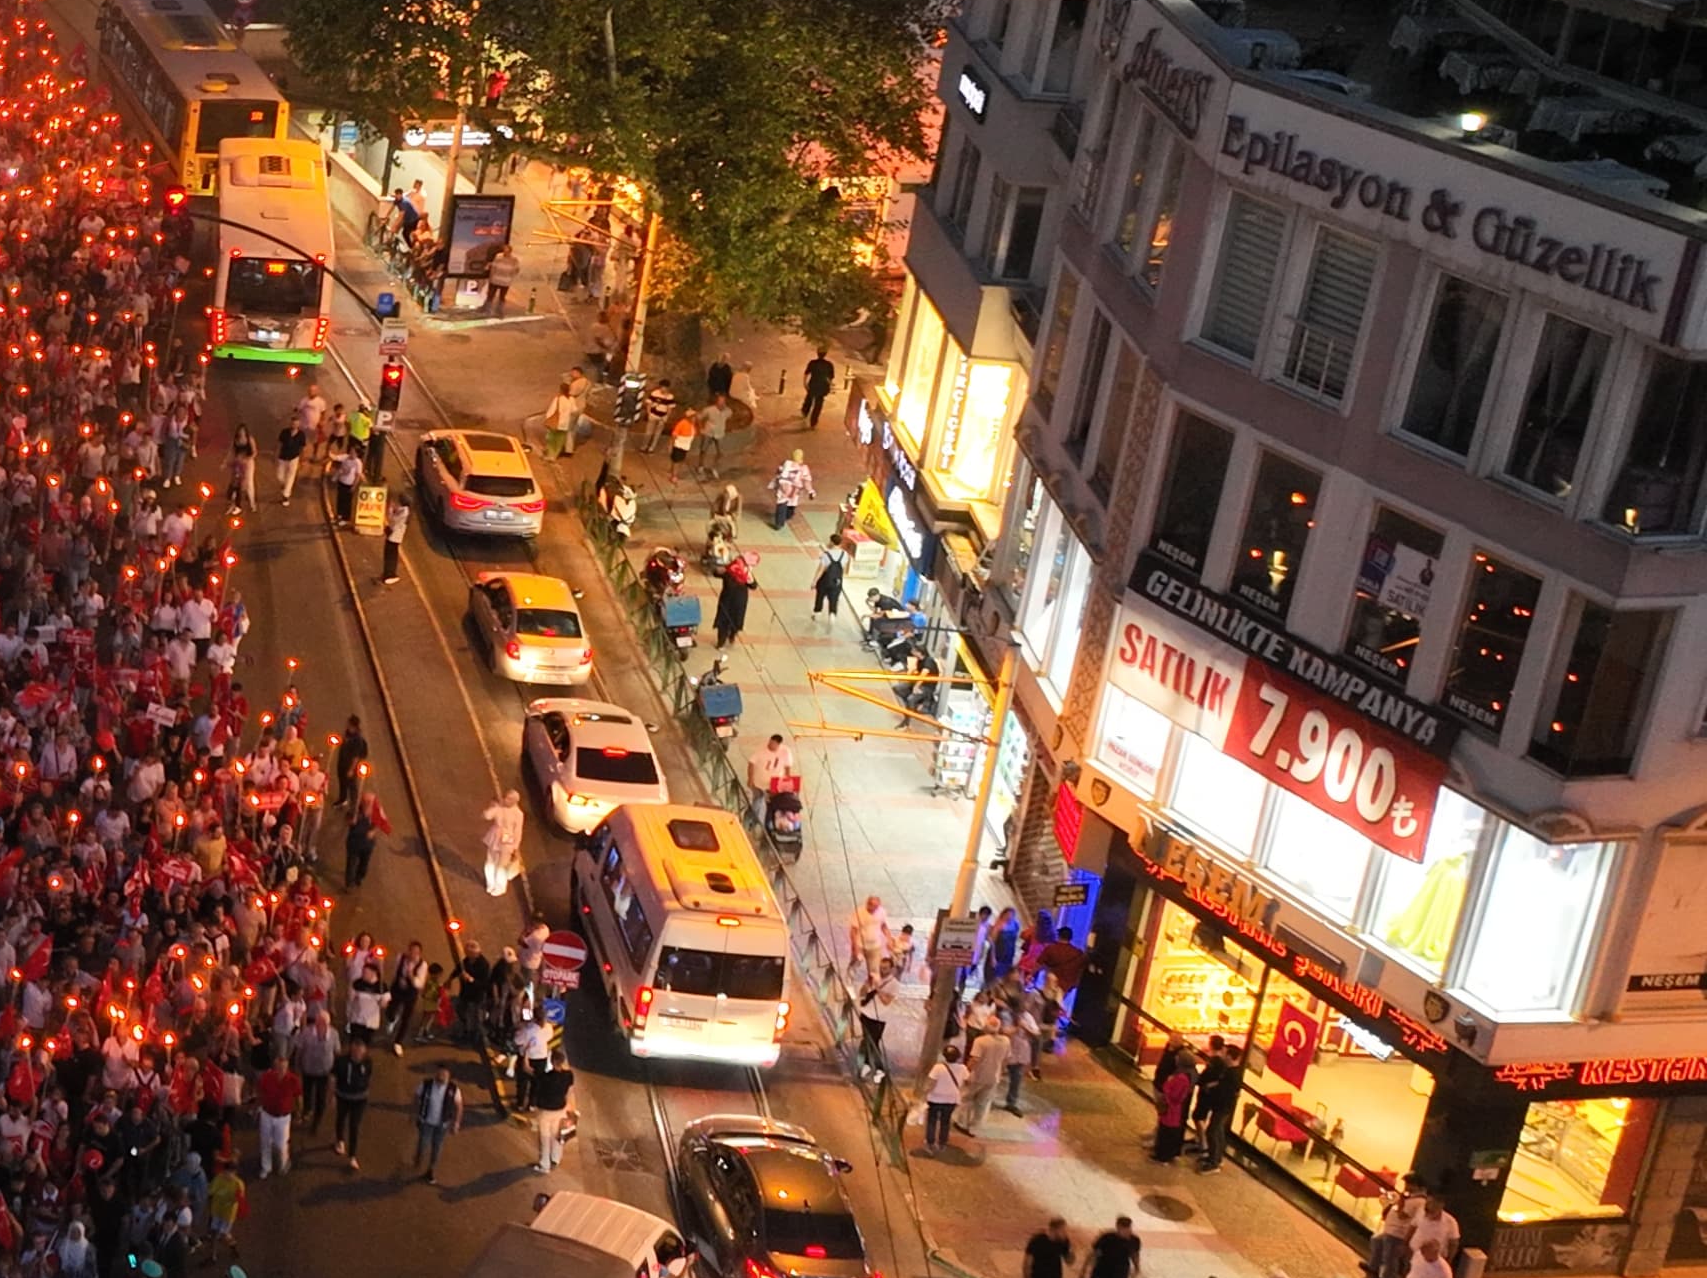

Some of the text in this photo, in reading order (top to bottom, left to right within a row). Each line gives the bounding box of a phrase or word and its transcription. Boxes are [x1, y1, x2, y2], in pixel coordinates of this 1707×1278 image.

[1219, 115, 1662, 313] Epilasyon & Güzellik
[1119, 622, 1232, 722] SATILIK
[1288, 645, 1437, 746] KAMPANYA
[1640, 973, 1700, 990] NEŞEM
